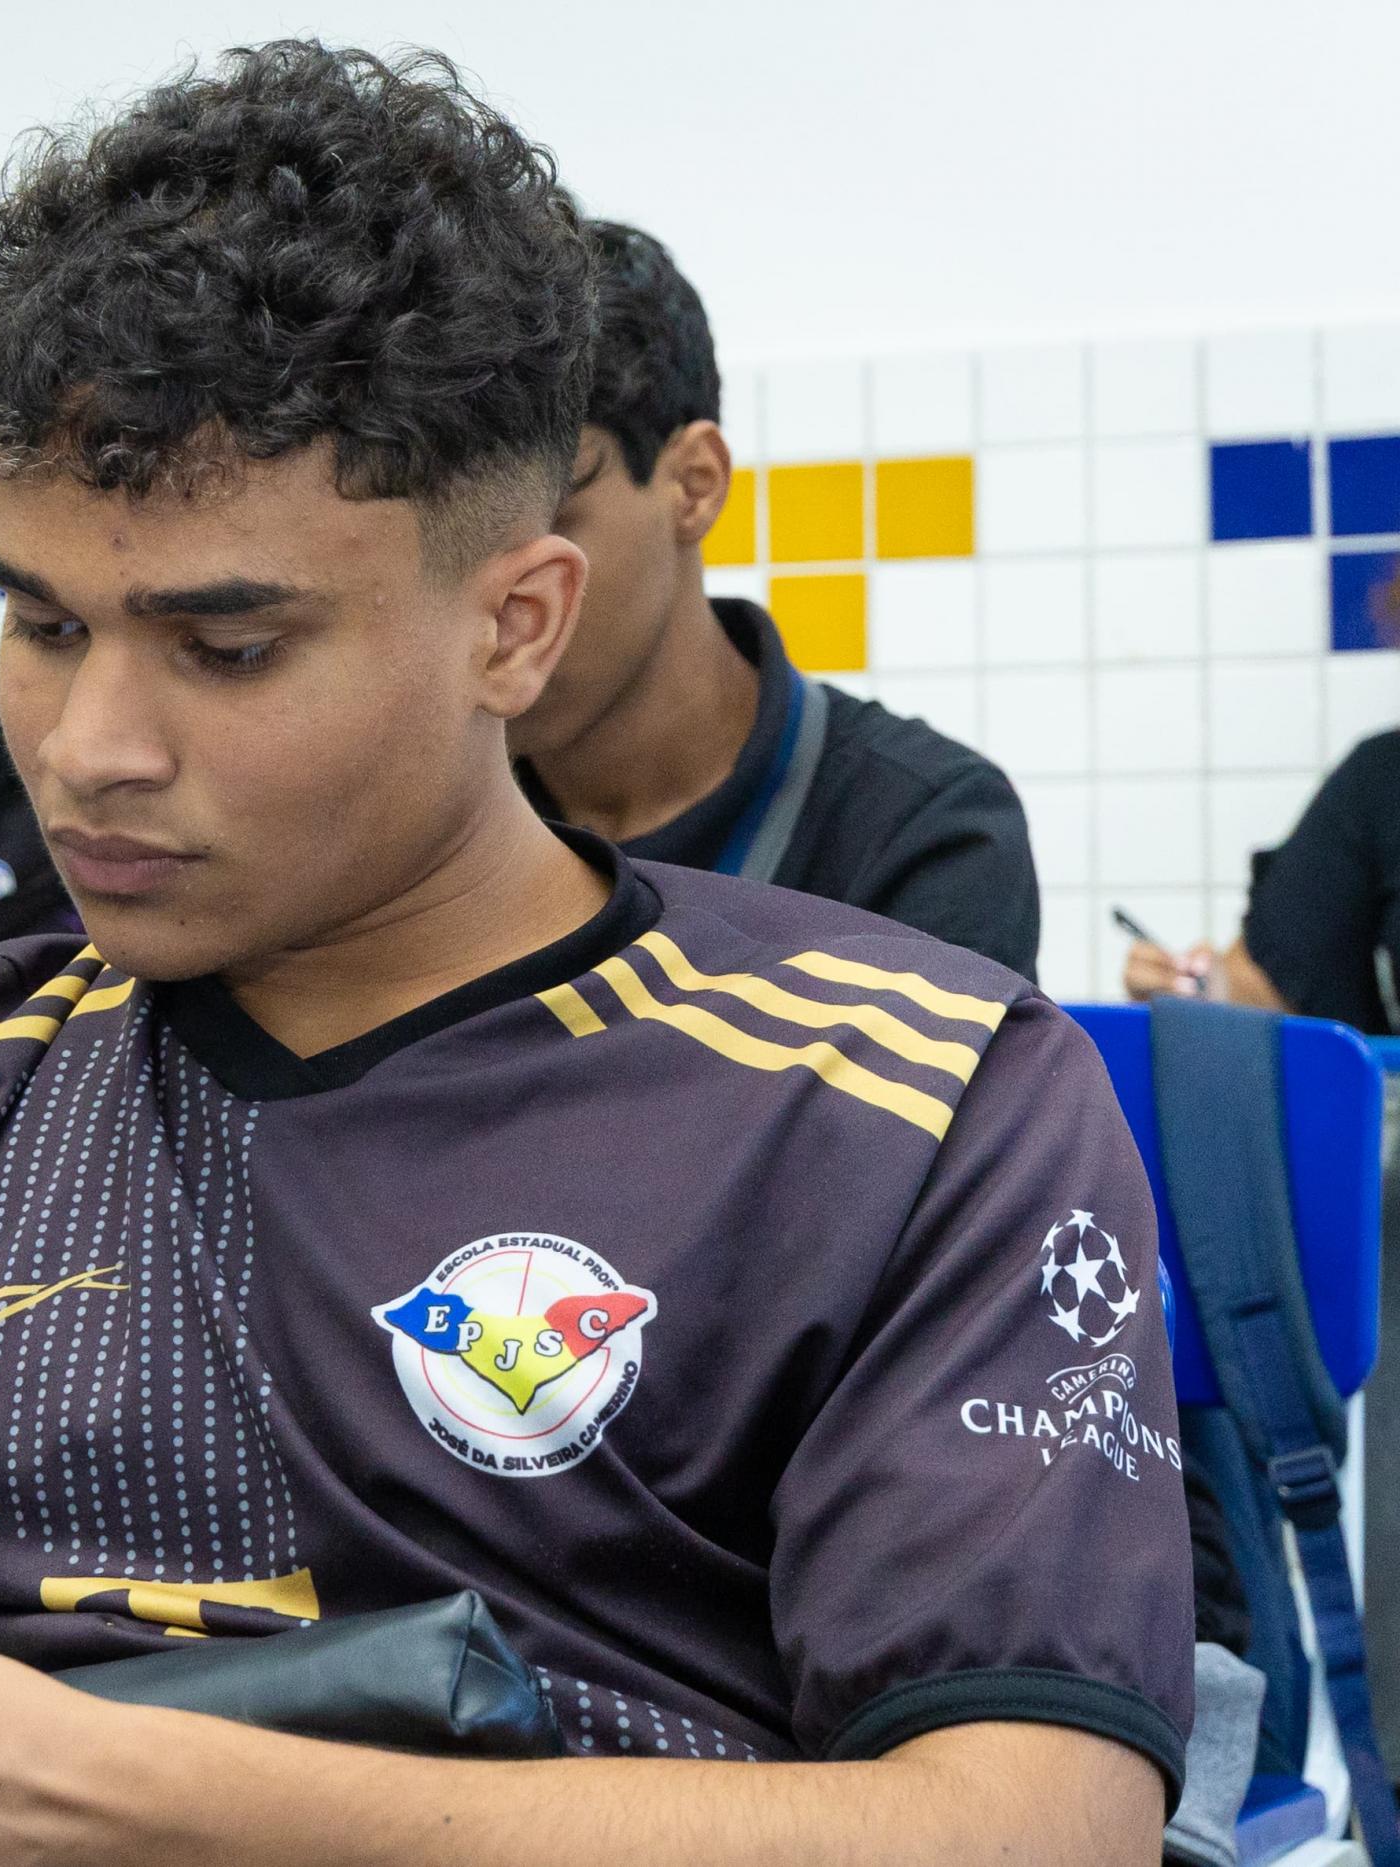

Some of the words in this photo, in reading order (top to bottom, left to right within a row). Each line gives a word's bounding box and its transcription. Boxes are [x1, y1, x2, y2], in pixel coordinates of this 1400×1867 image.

[436, 1241, 494, 1282] ESCOLA
[498, 1236, 581, 1262] ESTADUAL
[1051, 1358, 1135, 1401] CAMERINO
[428, 1417, 468, 1457] JOSÉ
[472, 1448, 498, 1470] DA
[503, 1441, 584, 1471] SILVEIRA
[579, 1360, 638, 1447] CAMERINO
[961, 1389, 1182, 1471] CHAMPIONS
